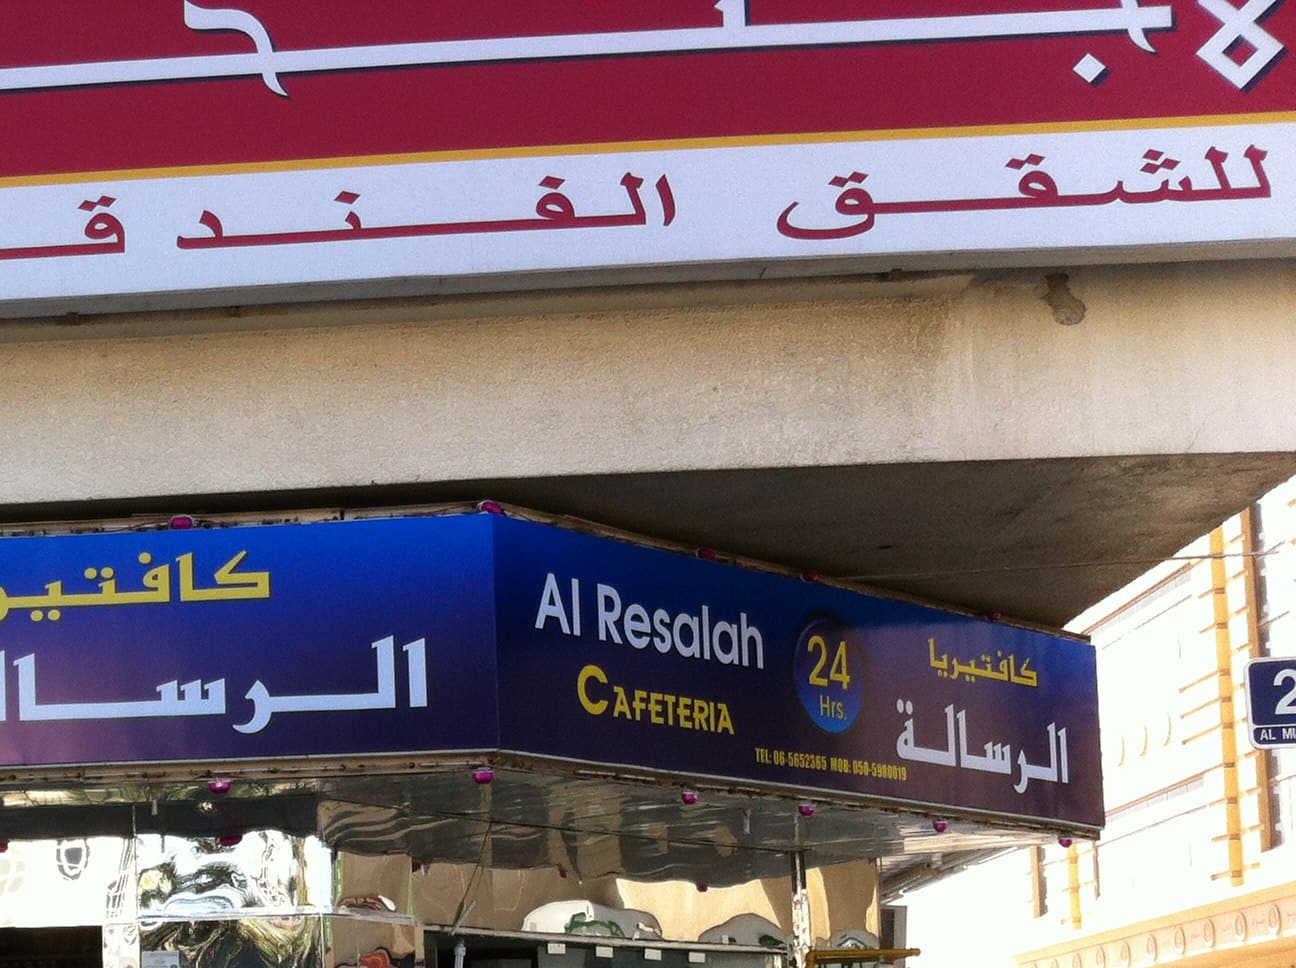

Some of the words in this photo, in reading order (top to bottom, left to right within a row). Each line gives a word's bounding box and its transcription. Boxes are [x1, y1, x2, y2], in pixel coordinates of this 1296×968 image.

[776, 144, 1272, 241] للشقق
[535, 572, 581, 636] Al
[596, 583, 764, 669] Resalah
[807, 635, 851, 690] 24
[928, 638, 1038, 687] كافتيريا
[819, 694, 847, 720] Hrs.
[896, 698, 1069, 794] الرسالة
[1260, 729, 1276, 740] AL
[773, 750, 826, 770] 06-5652365
[853, 760, 907, 781] 050-5980019
